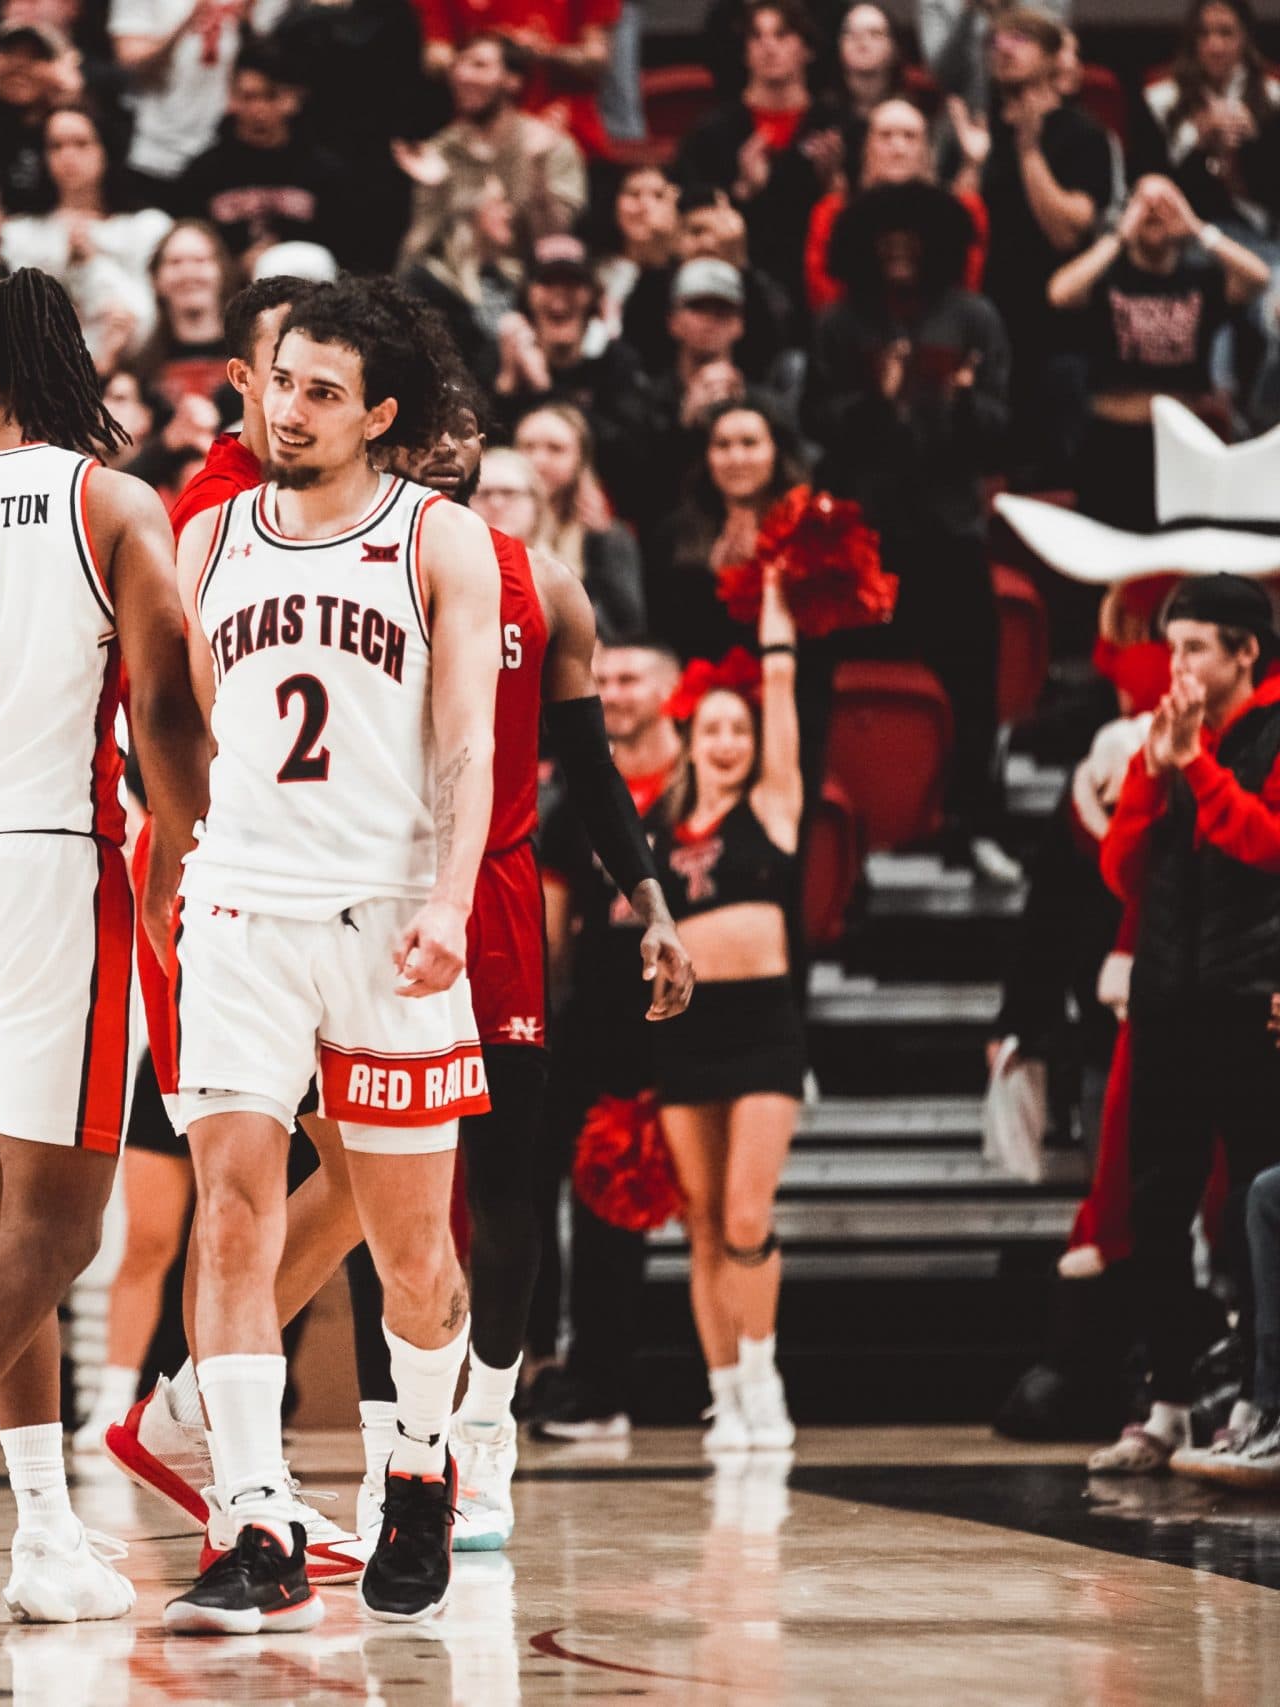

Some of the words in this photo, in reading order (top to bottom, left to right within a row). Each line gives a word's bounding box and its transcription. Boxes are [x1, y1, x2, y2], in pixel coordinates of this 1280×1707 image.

[316, 595, 406, 685] TECH
[275, 673, 330, 784] 2
[347, 1063, 412, 1110] RED
[425, 1056, 489, 1109] RAID
